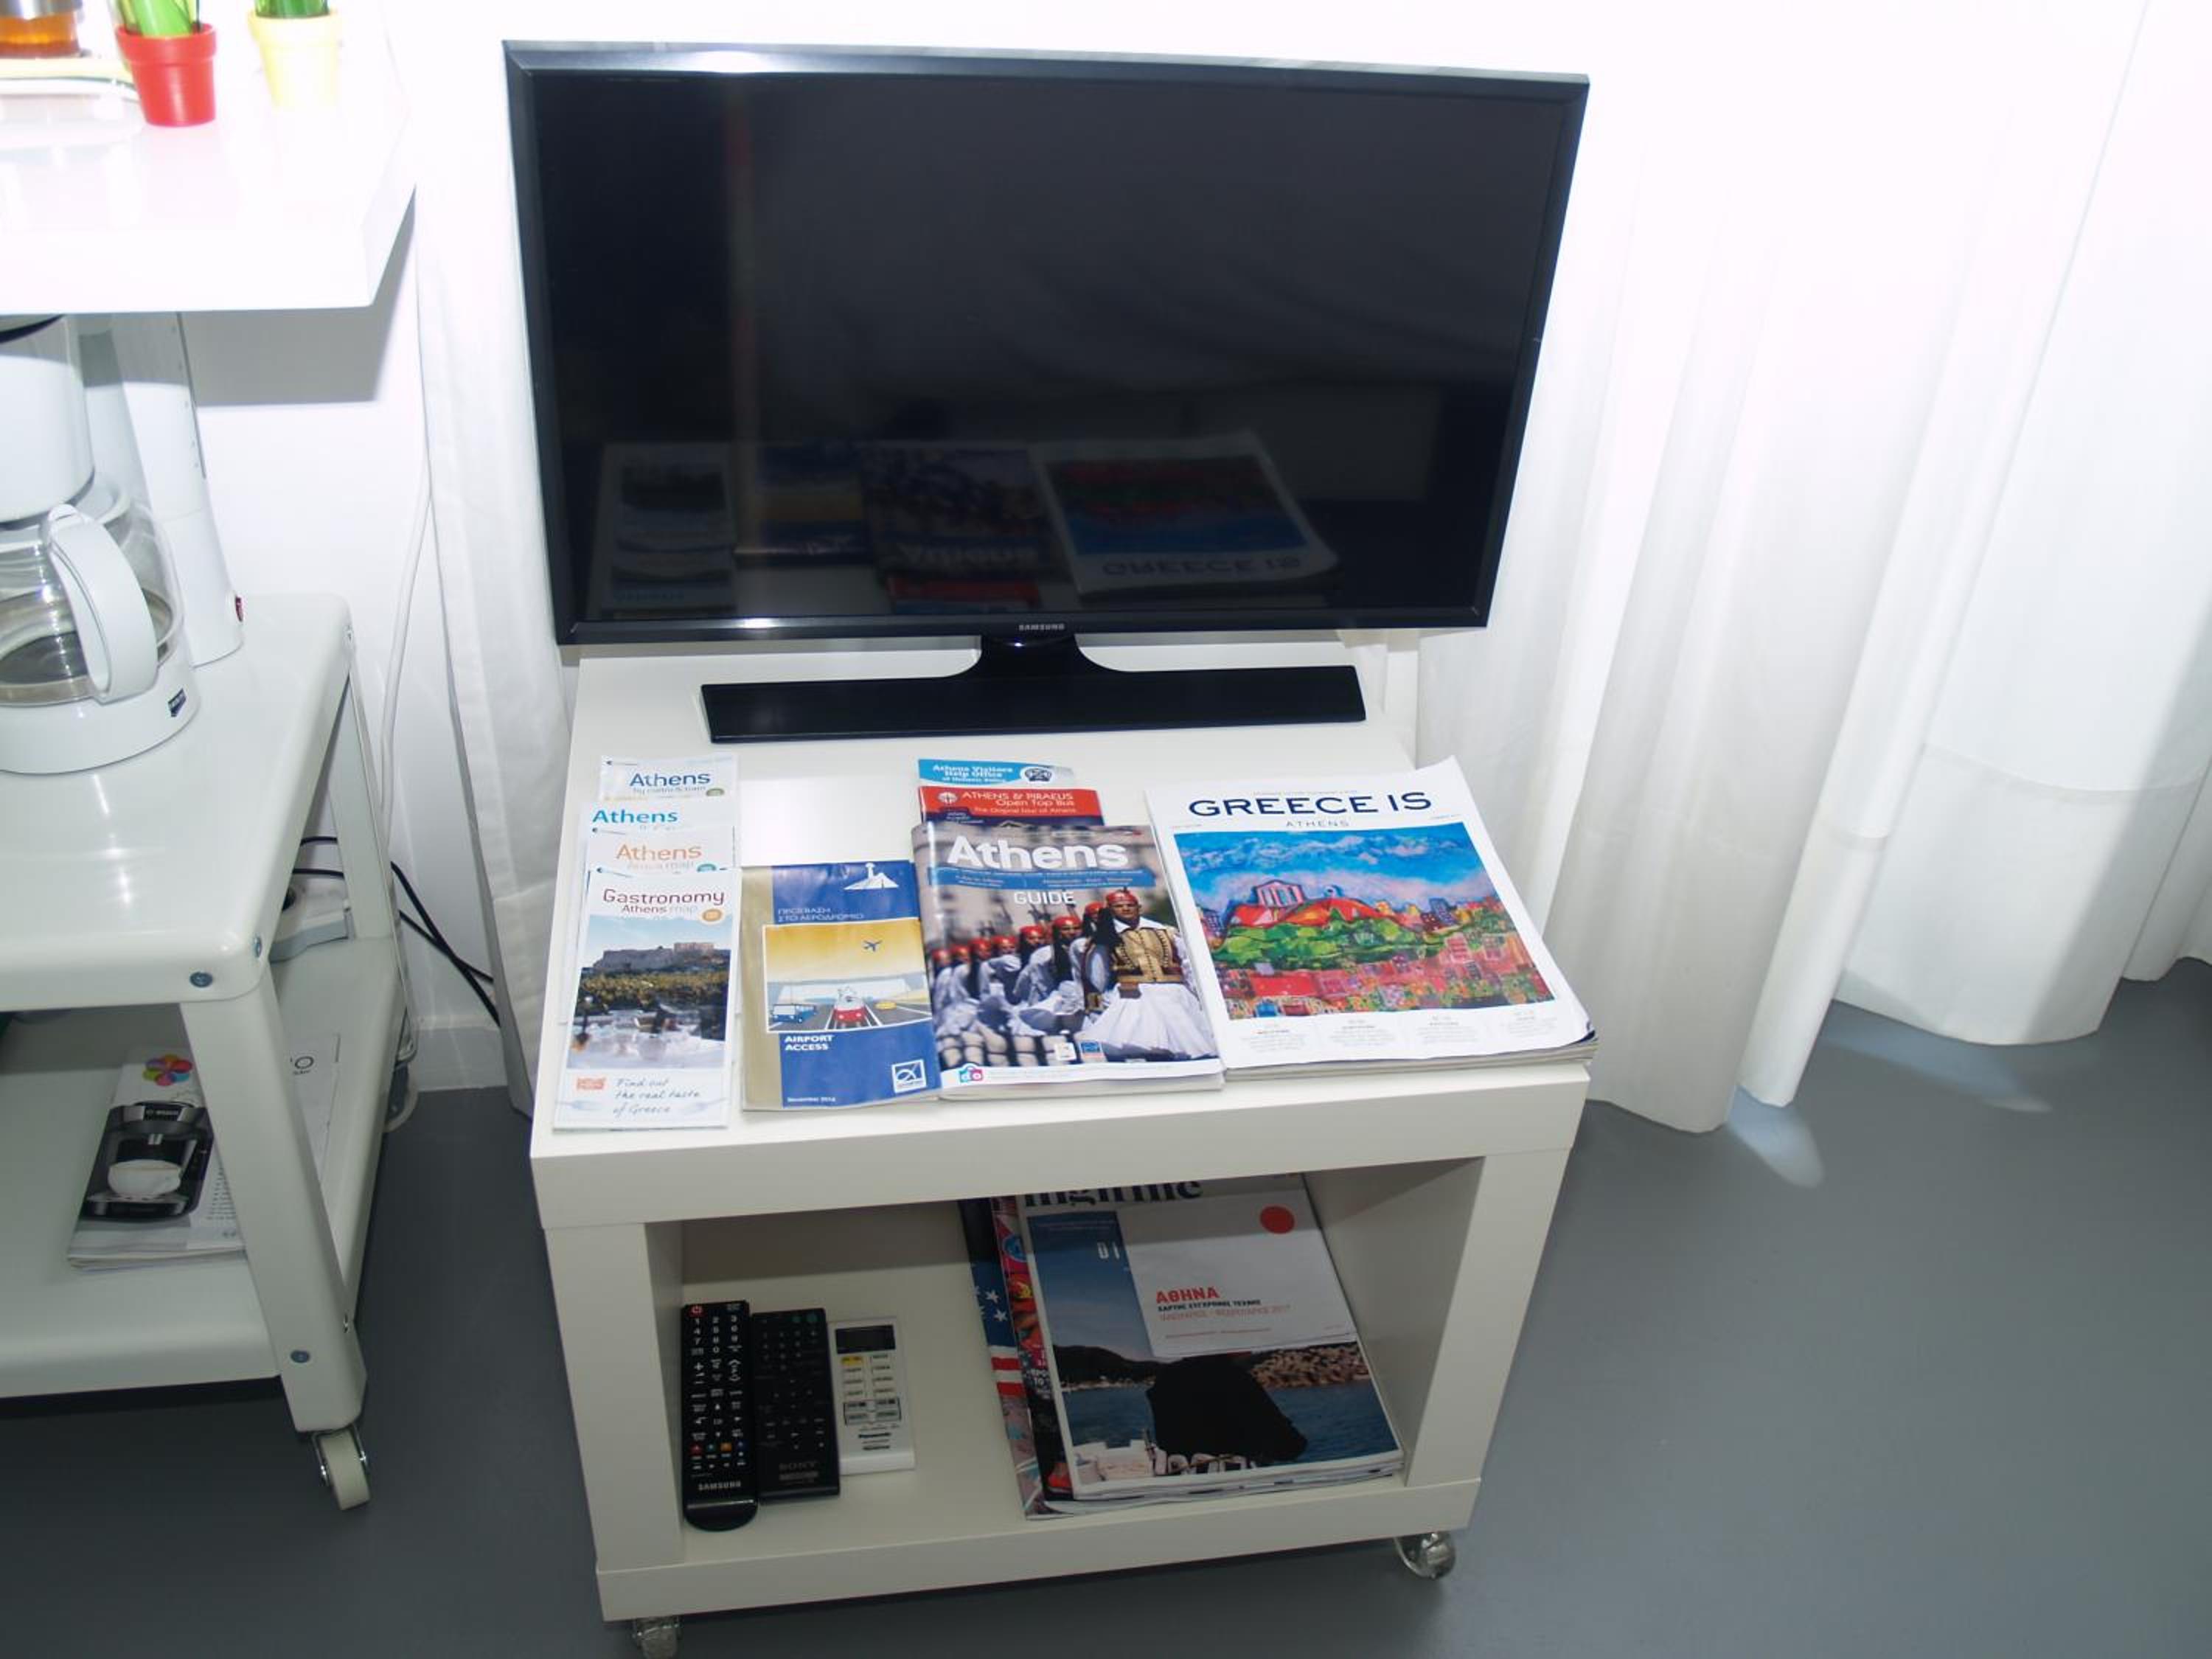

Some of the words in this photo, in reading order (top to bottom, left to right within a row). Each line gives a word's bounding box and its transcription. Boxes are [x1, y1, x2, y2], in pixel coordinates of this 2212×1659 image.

[629, 773, 712, 787] Athens
[961, 791, 1009, 800] ATHENS
[1026, 792, 1074, 800] PIRAEUS
[995, 799, 1028, 807] Open
[1032, 799, 1053, 807] Top
[1189, 796, 1378, 816] GREECE
[1388, 793, 1432, 811] IS
[592, 809, 678, 824] Athens
[616, 844, 703, 861] Athens
[947, 835, 1129, 869] Athens
[603, 888, 726, 906] Gastronomy
[1014, 890, 1075, 905] GUIDE
[622, 905, 667, 914] Athens
[785, 1034, 835, 1043] AIRPORT
[617, 1077, 645, 1087] Find
[615, 1090, 636, 1099] the
[639, 1091, 666, 1099] real
[630, 1104, 671, 1115] Greece
[1156, 1286, 1220, 1304] ΑΘΗΝΑ
[698, 1481, 741, 1490] SAMSUNG
